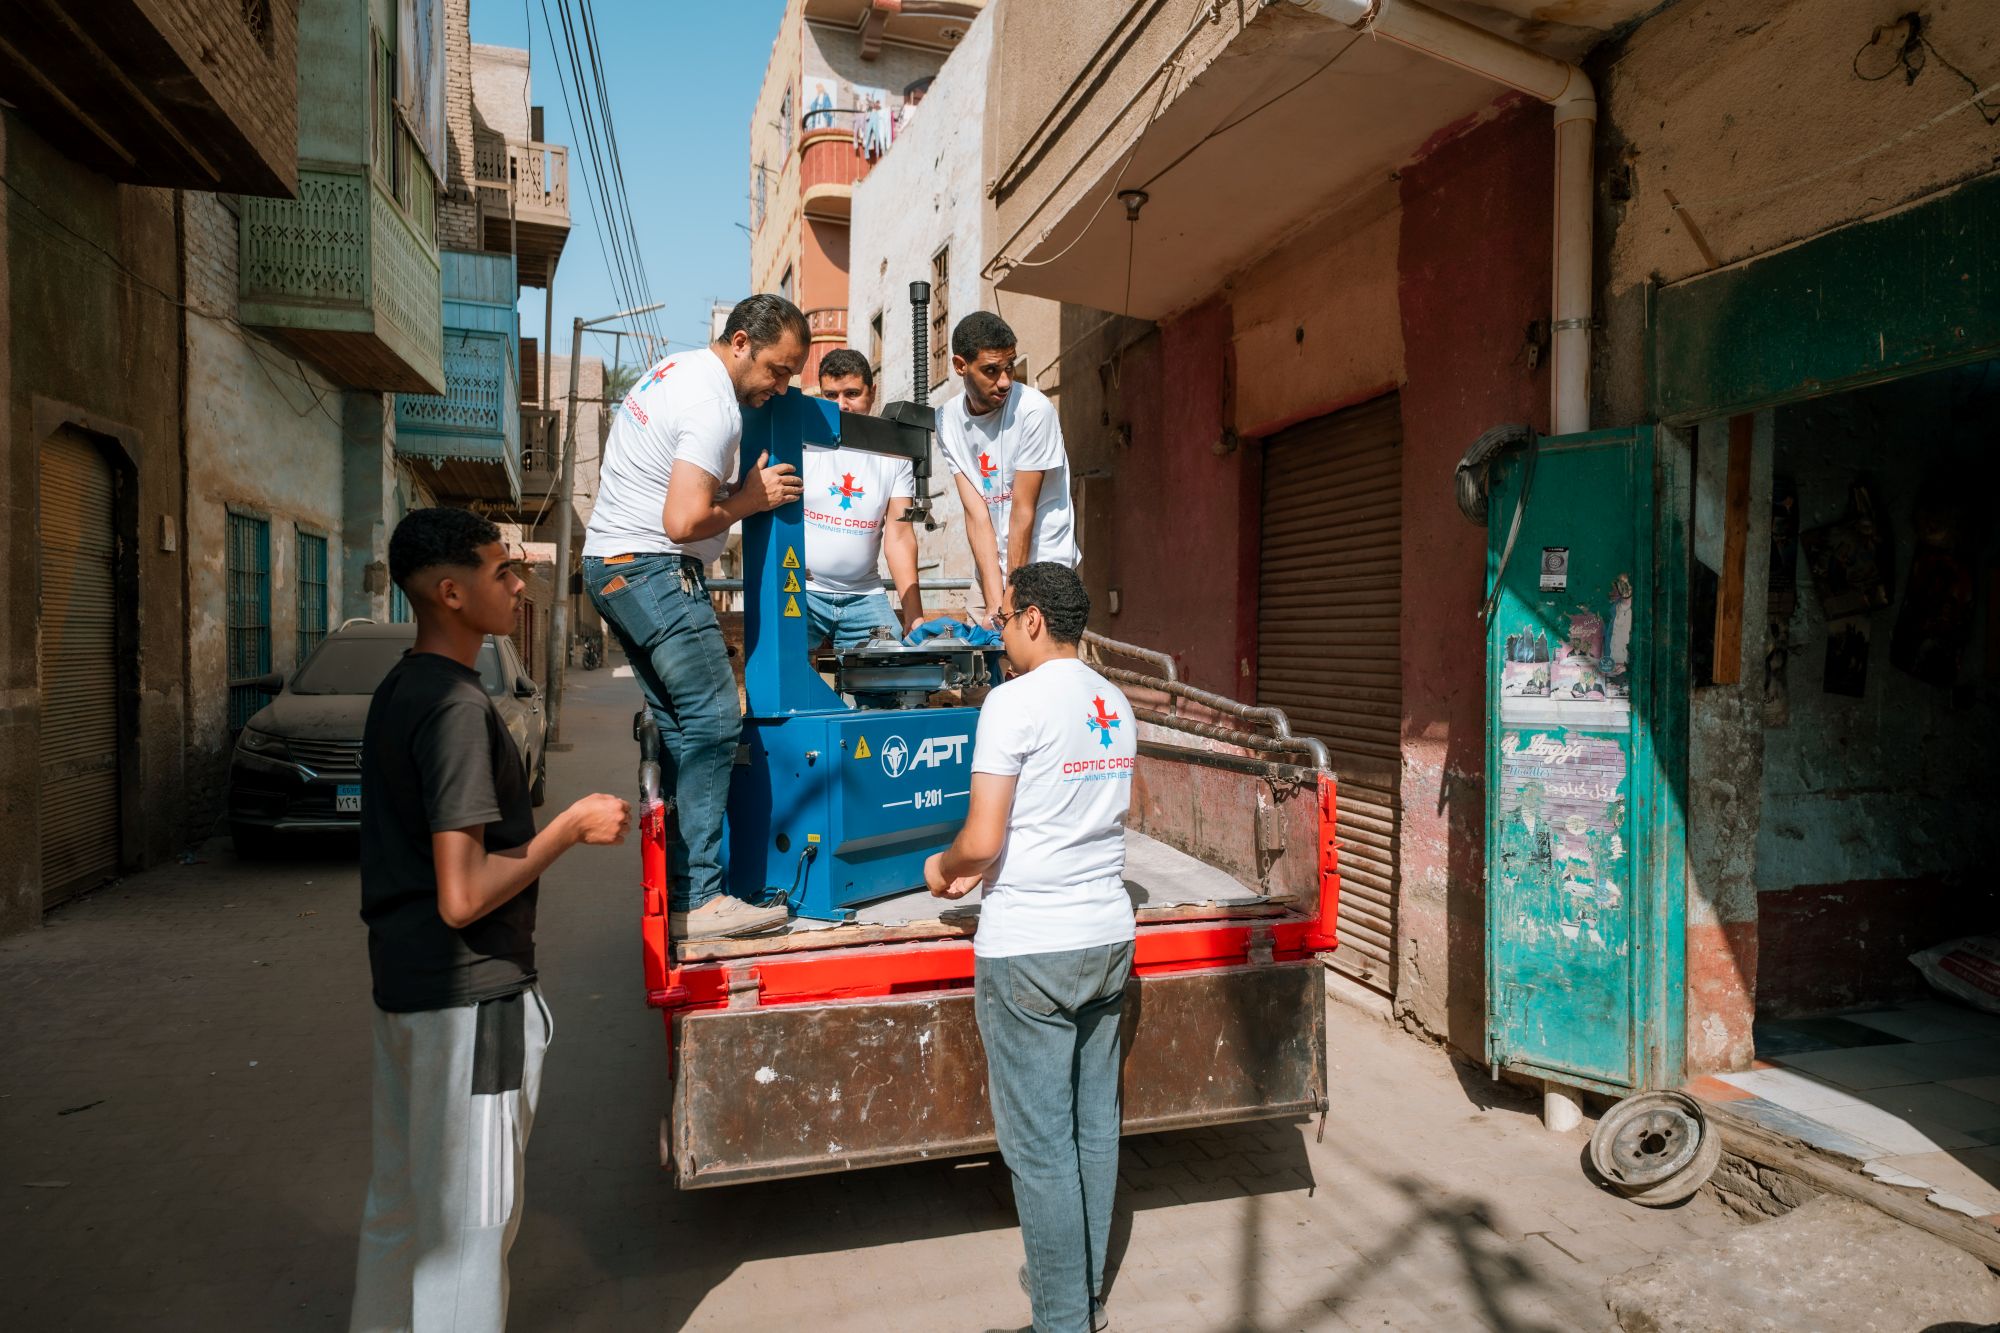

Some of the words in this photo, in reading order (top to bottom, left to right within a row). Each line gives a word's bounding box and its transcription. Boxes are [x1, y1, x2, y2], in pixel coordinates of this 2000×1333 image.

[803, 508, 842, 525] COPTIC
[844, 518, 879, 529] CROSS
[817, 523, 864, 536] MINISTRIES
[908, 734, 969, 771] APT
[1063, 759, 1105, 774] COPTIC
[1108, 757, 1135, 769] CROS
[1084, 771, 1128, 782] MINISTRIES
[914, 788, 943, 810] U-201
